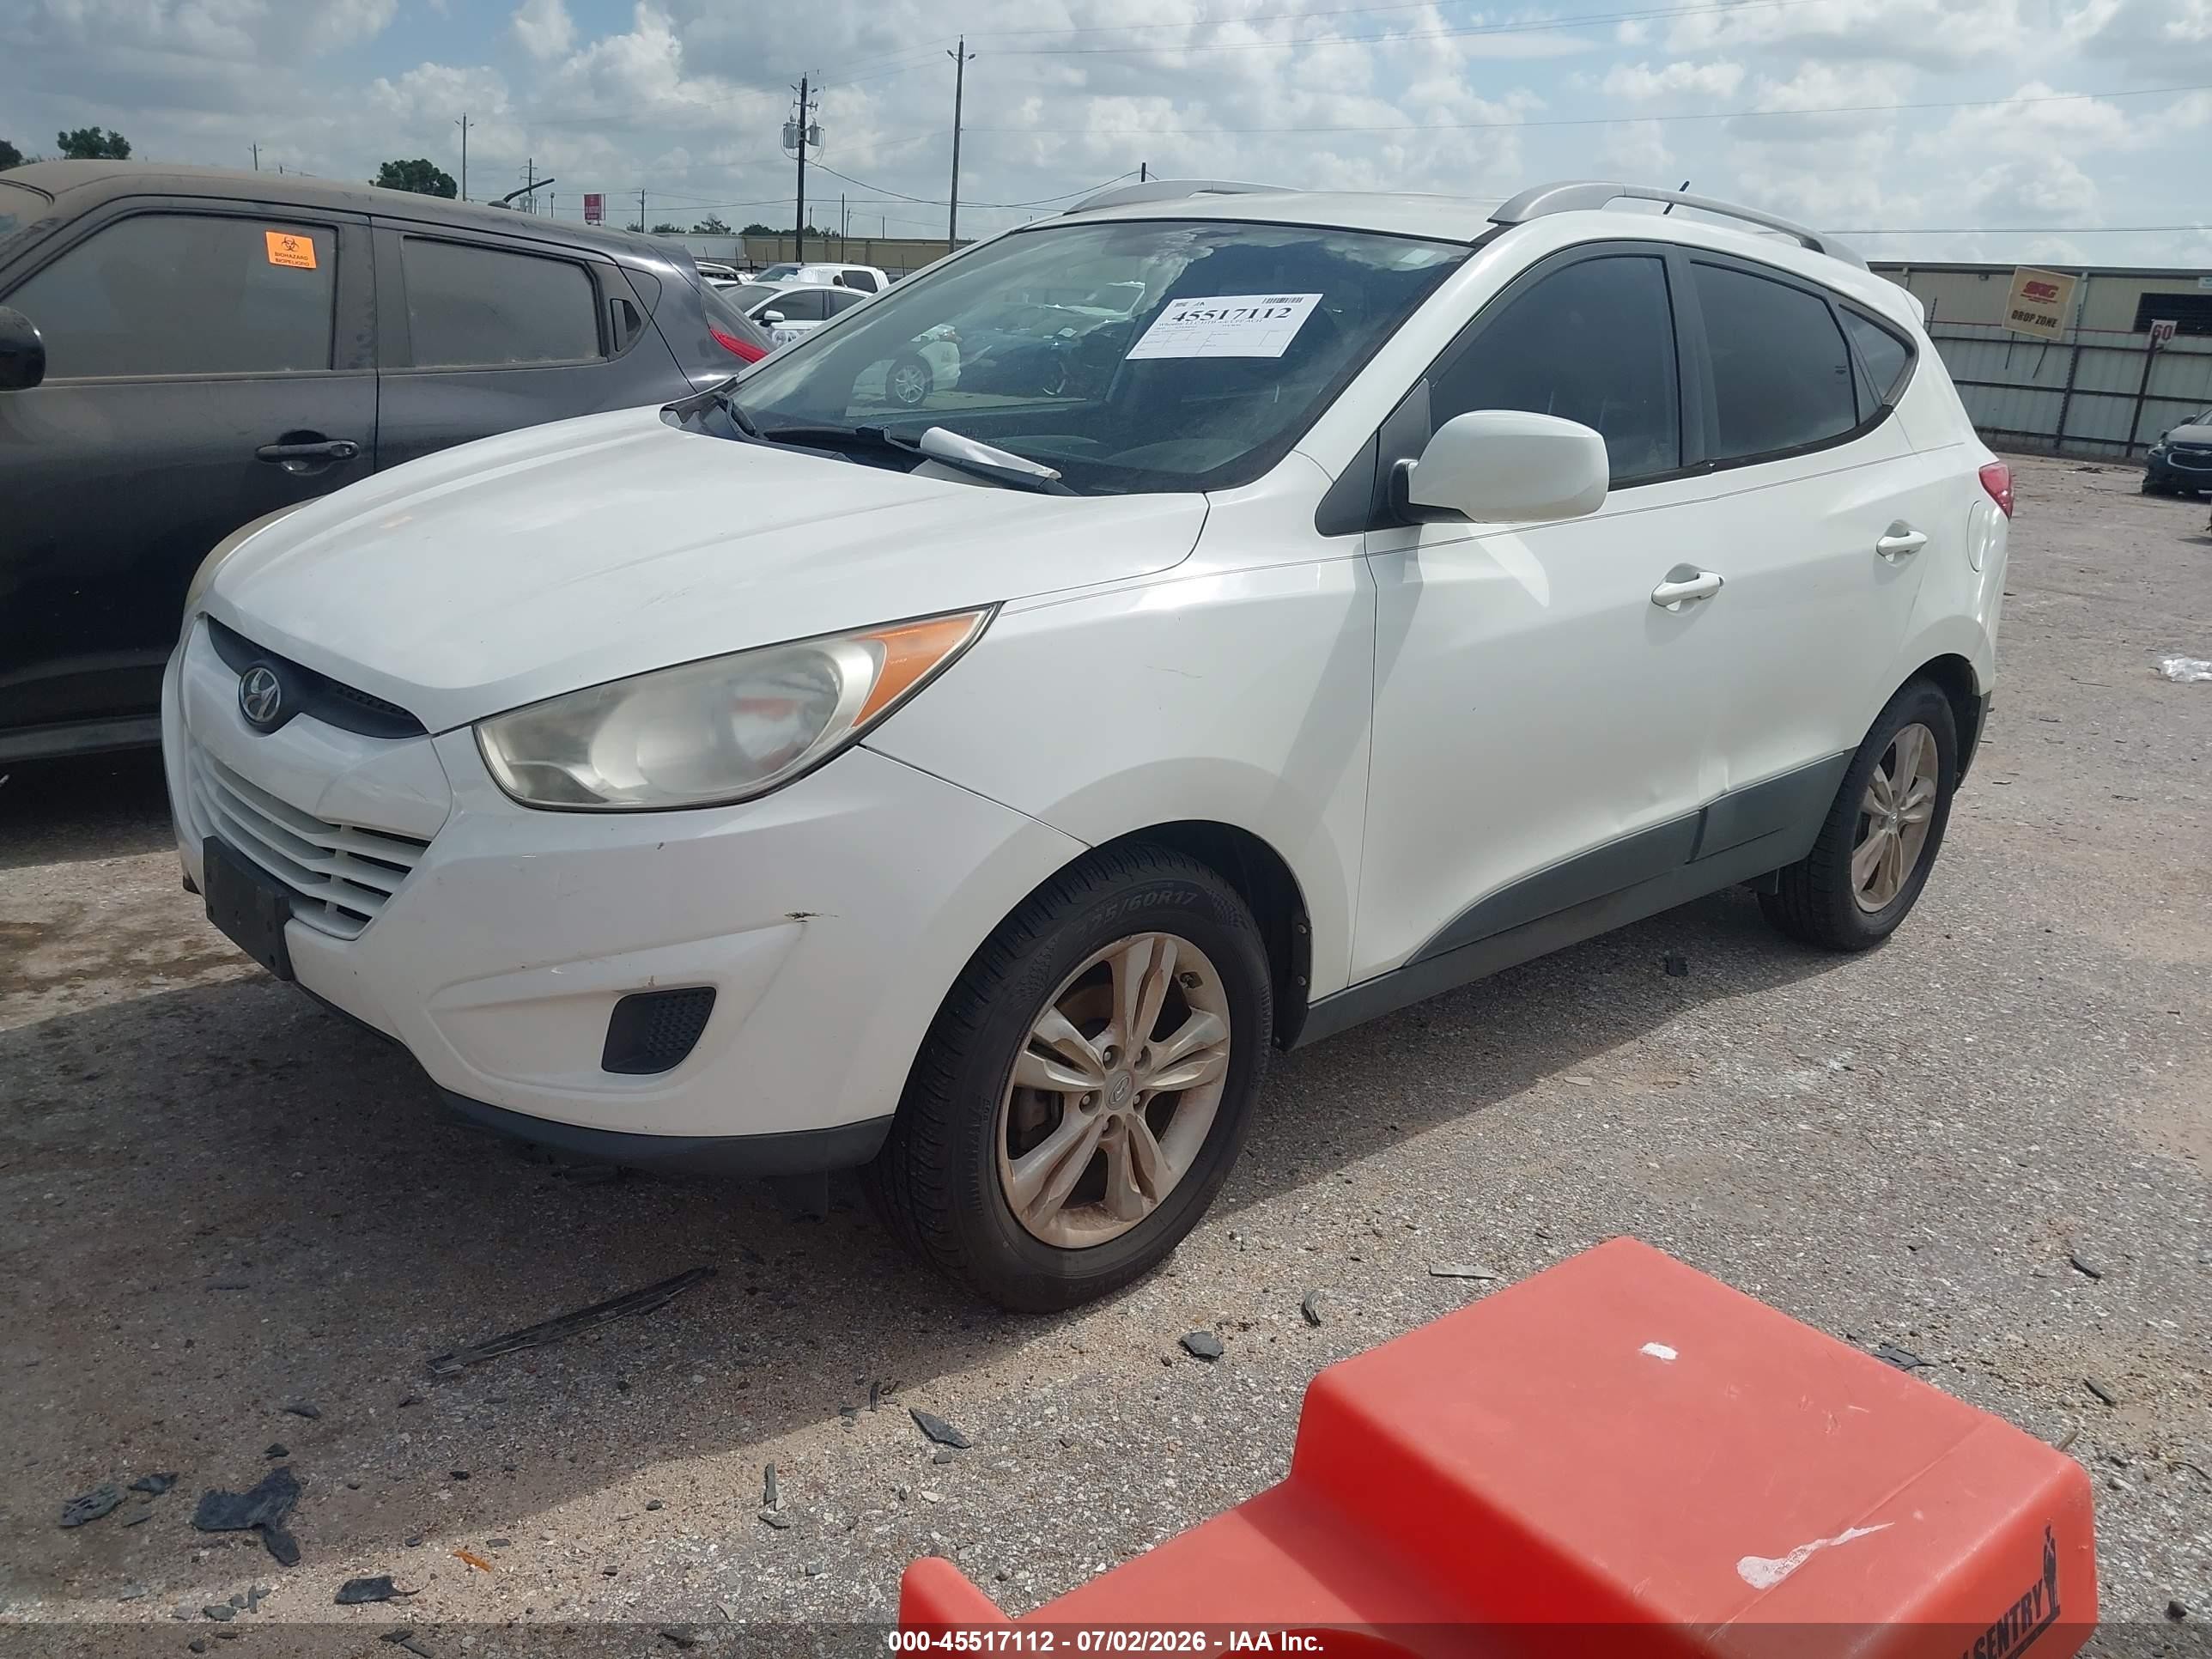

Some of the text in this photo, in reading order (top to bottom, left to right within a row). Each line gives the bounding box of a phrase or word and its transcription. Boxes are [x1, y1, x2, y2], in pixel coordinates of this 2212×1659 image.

[275, 252, 308, 260] BIOHAZARD
[275, 258, 310, 266] BIOPELIGRO
[1172, 307, 1292, 322] 45517112
[2011, 310, 2058, 328] DROP ZONE
[2154, 325, 2173, 341] 60
[1973, 1577, 2043, 1659] SENTRY
